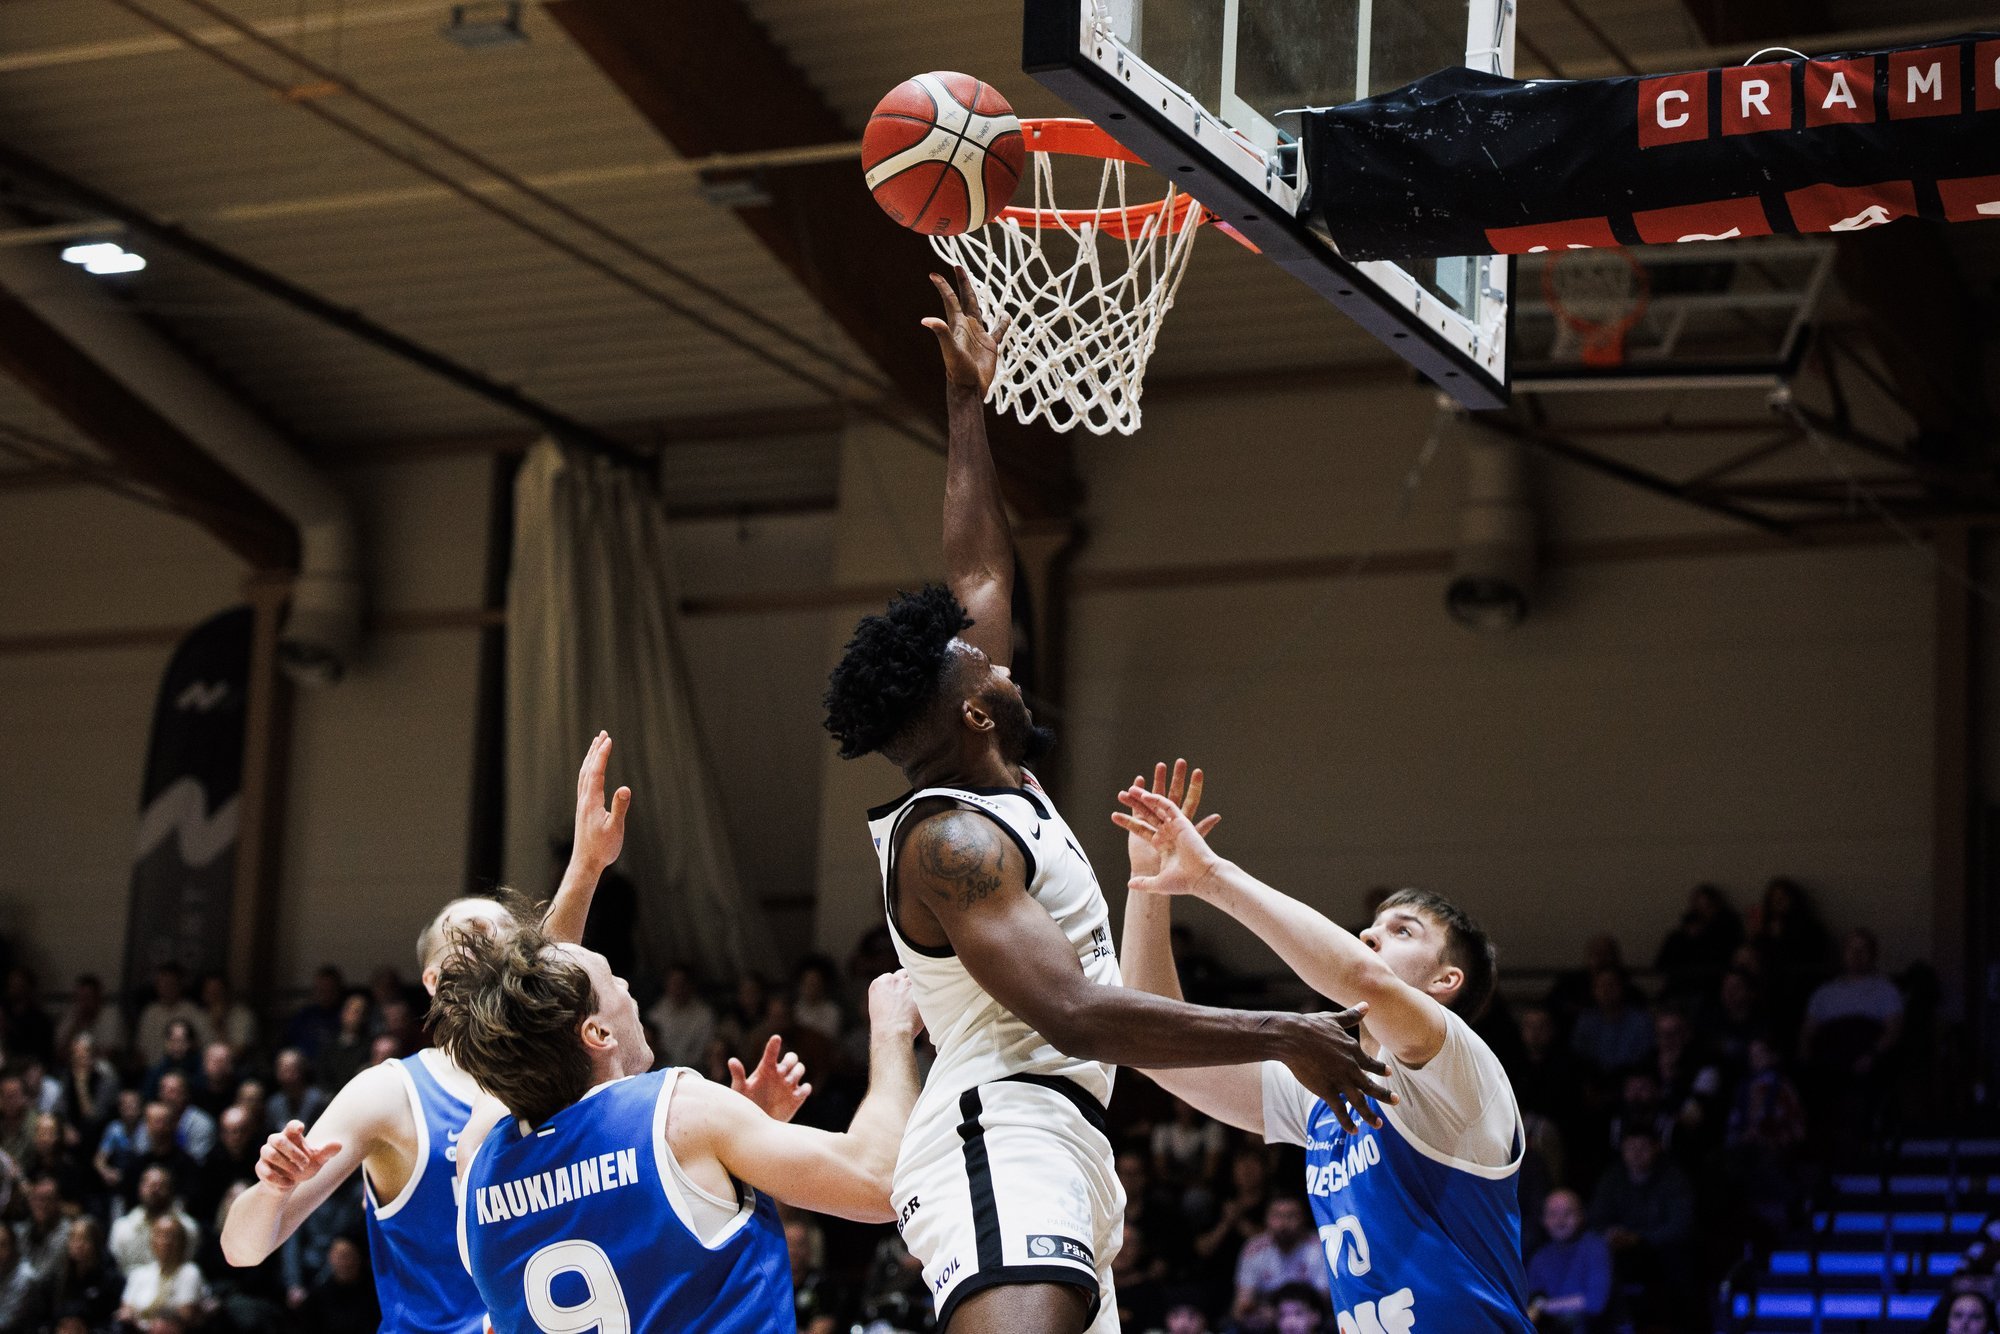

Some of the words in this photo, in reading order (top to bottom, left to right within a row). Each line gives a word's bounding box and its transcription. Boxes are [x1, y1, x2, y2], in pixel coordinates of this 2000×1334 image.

[1656, 57, 2000, 129] CRAM
[476, 1148, 639, 1226] KAUKIAINEN
[524, 1239, 631, 1334] 9
